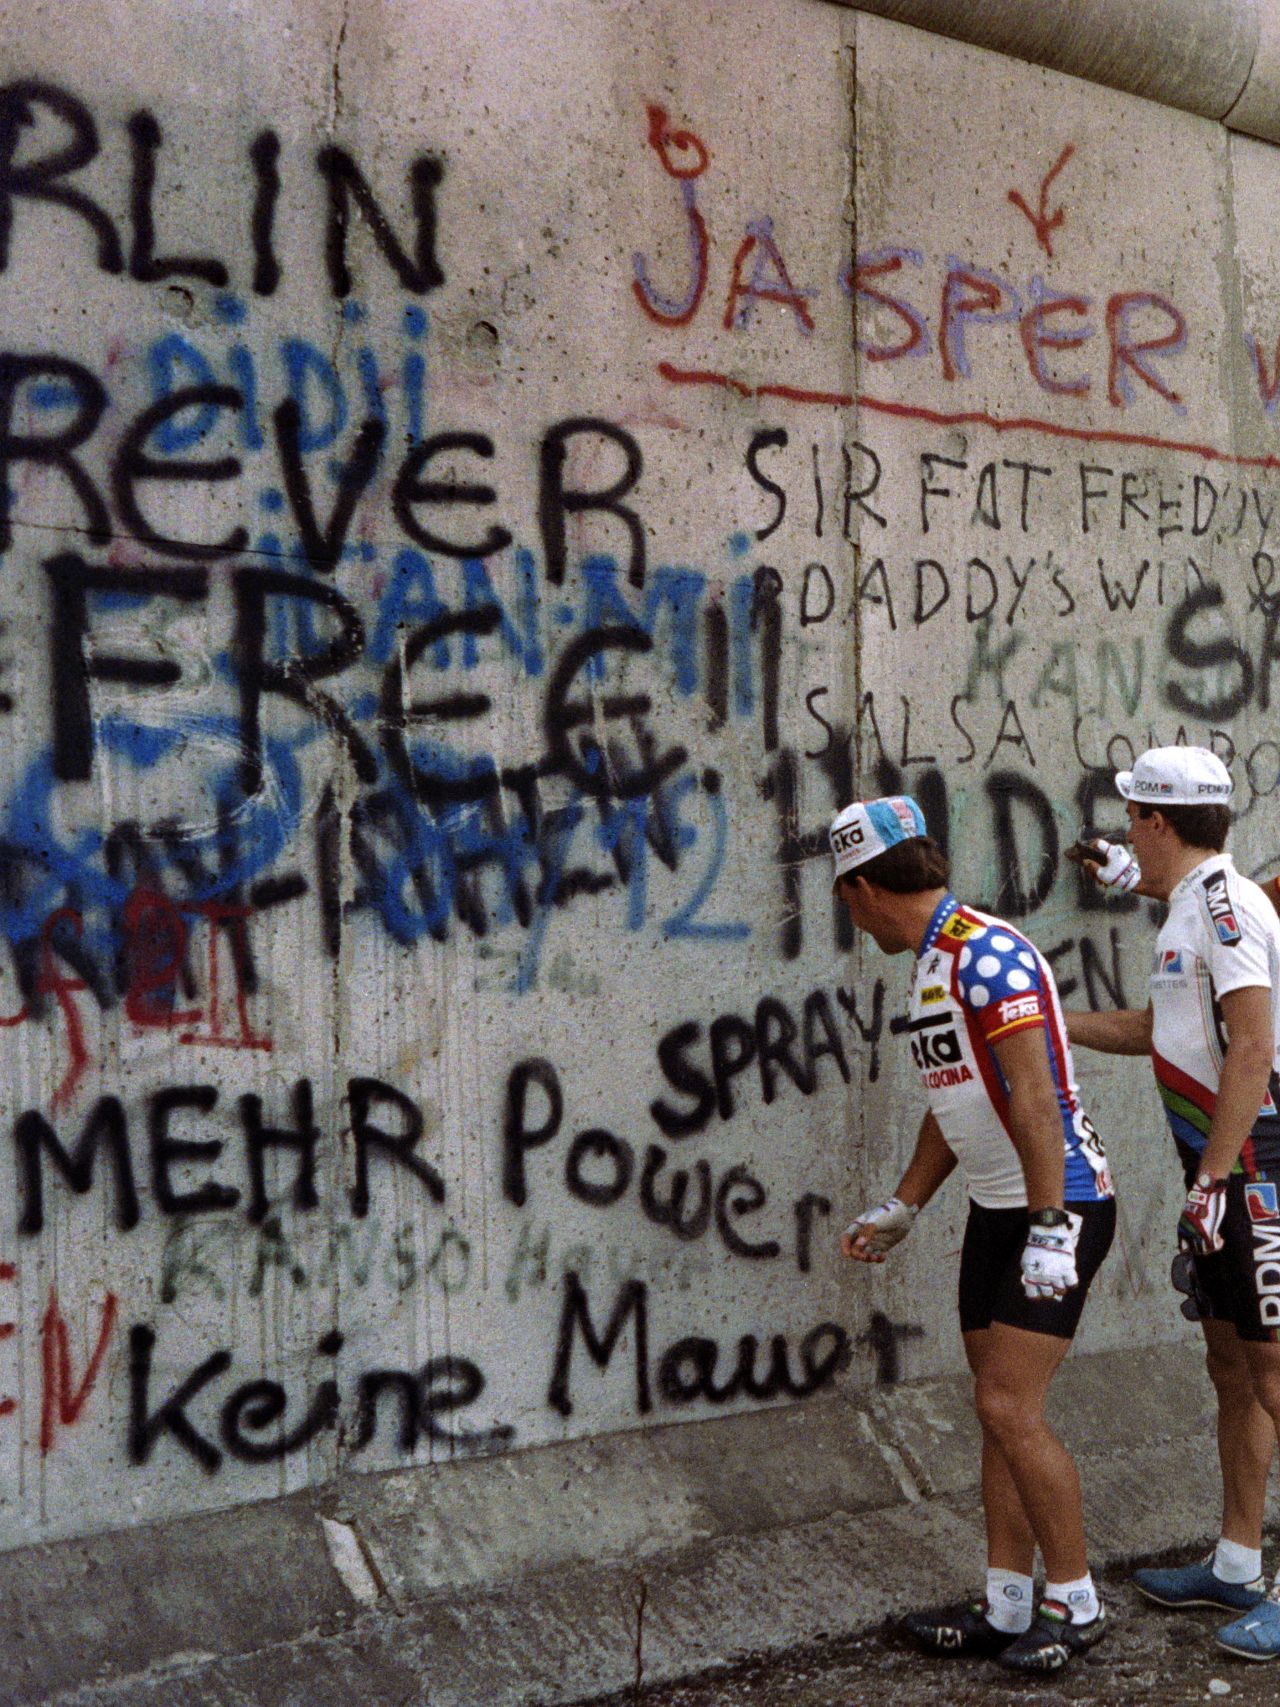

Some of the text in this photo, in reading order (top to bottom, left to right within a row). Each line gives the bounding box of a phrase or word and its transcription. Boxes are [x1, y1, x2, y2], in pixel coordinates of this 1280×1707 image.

[633, 176, 1188, 416] JASPER
[746, 426, 888, 543] SIR
[919, 448, 1052, 536] FAT
[803, 684, 1037, 770] SALSA
[926, 1064, 974, 1089] COCINA
[12, 1076, 448, 1236] MEHR
[500, 1056, 832, 1274] Power
[127, 1272, 924, 1474] Keine Mauer
